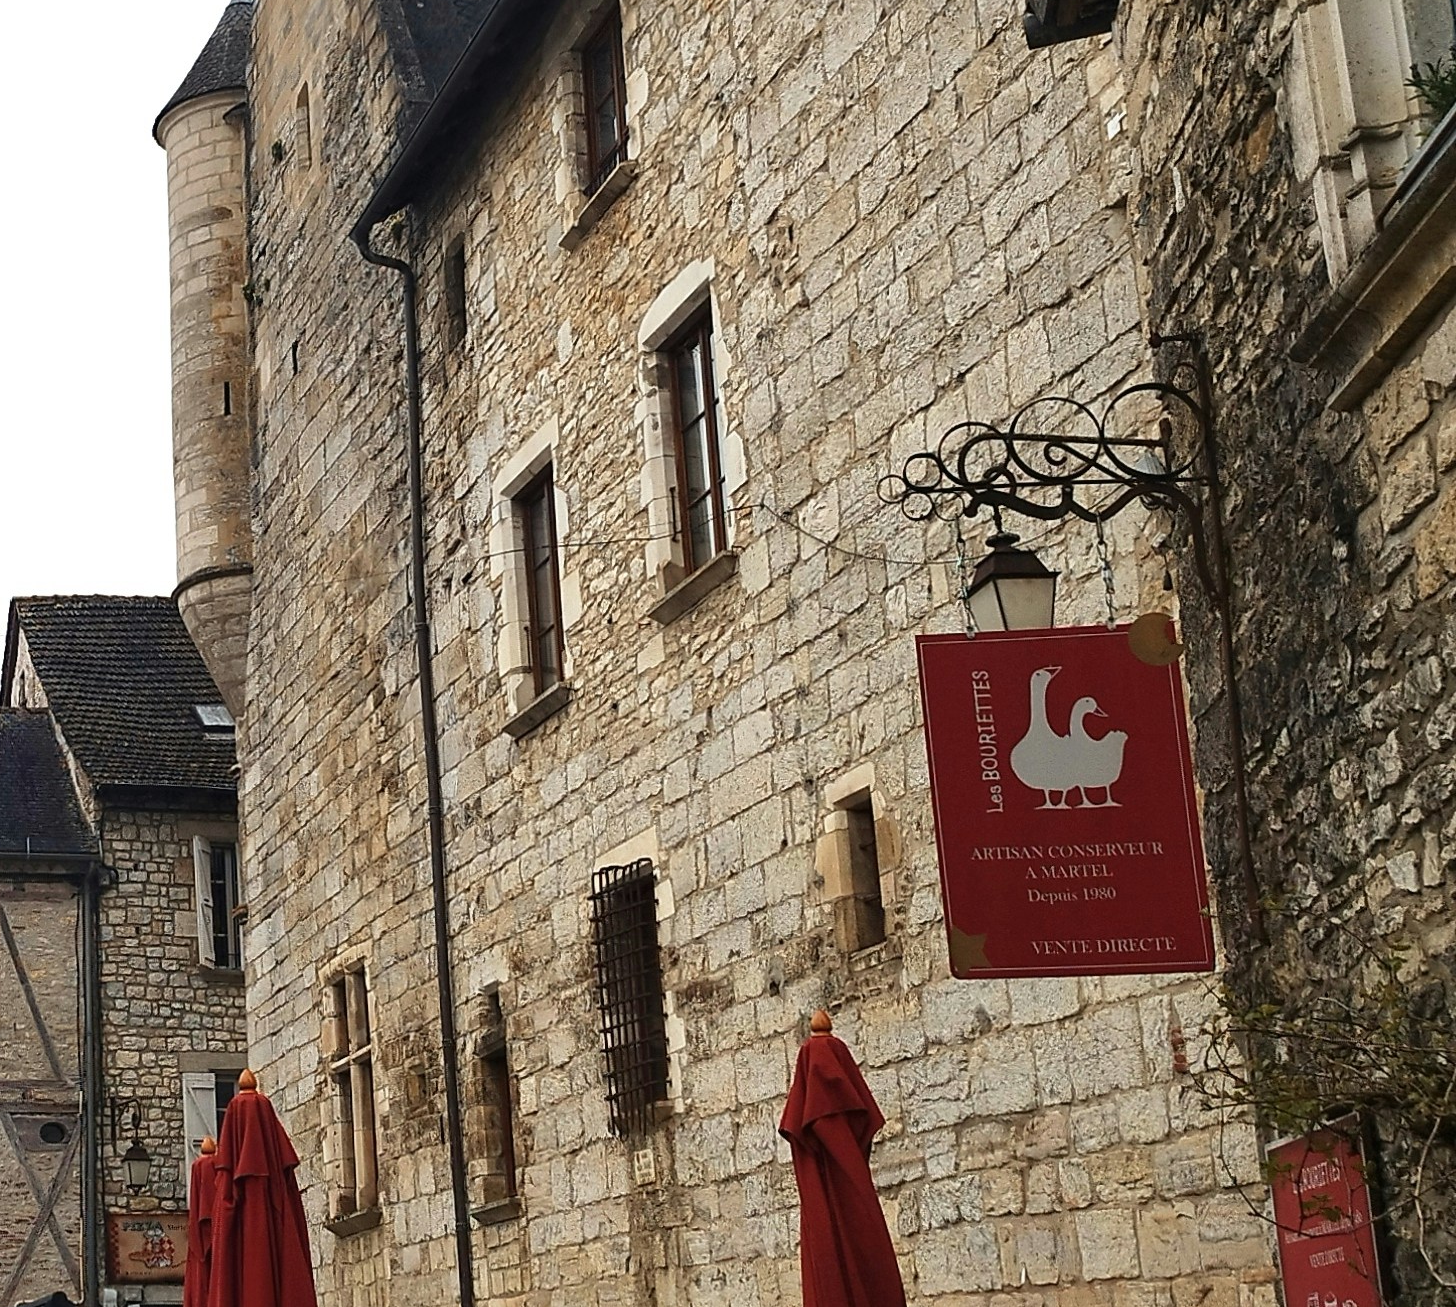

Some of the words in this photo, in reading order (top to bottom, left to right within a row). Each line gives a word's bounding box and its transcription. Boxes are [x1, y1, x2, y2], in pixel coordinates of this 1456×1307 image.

[971, 670, 1001, 781] BOURIETTES
[986, 784, 1004, 813] Les
[971, 845, 1044, 861] ARTISAN
[1048, 841, 1165, 859] CONSERVEUR
[1025, 866, 1038, 880] A
[1041, 864, 1114, 880] MARTEL
[1027, 888, 1078, 905] Depuis
[1083, 886, 1117, 901] 1980
[1031, 940, 1093, 955] VENTE
[1097, 936, 1177, 954] DIRECTE
